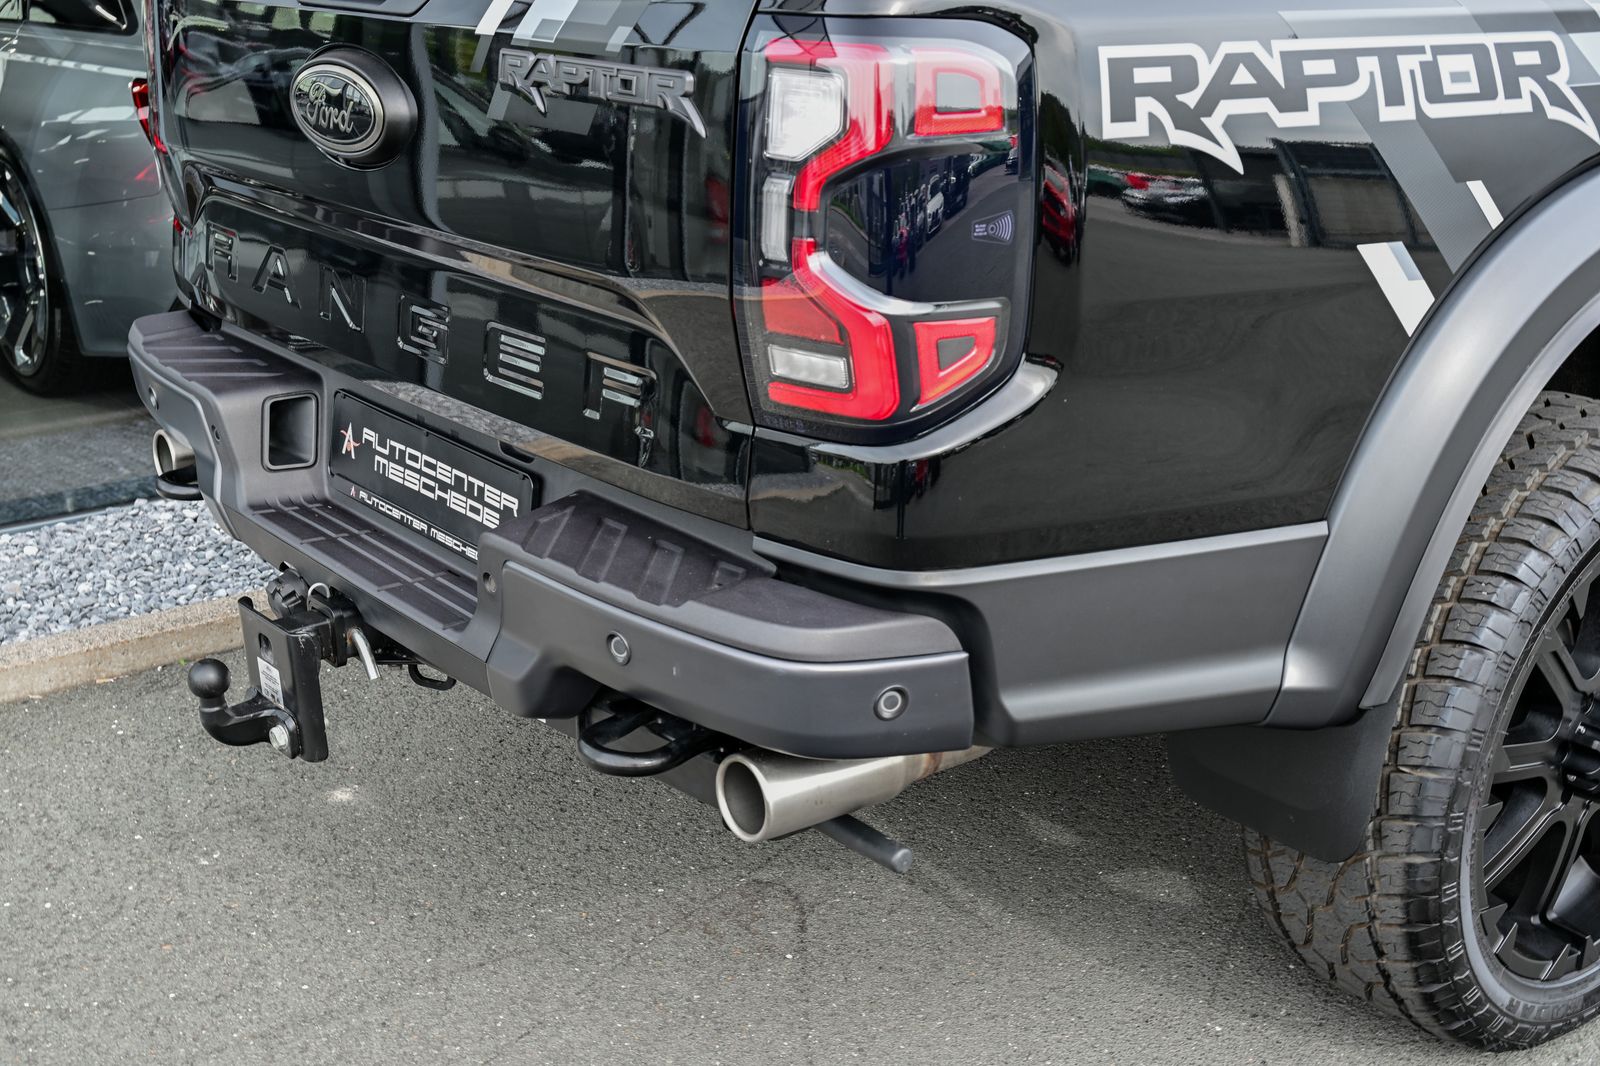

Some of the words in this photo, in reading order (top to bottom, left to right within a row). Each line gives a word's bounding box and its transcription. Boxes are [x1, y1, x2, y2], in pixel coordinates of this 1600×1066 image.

[306, 82, 354, 133] Ford
[499, 48, 707, 139] RAPTOR
[1098, 30, 1600, 174] RAPTOR
[205, 221, 657, 438] RANGER
[362, 427, 518, 517] AUTOCENTER
[374, 455, 500, 529] MESCHEDE
[359, 490, 428, 534] AUTOCENTER
[430, 527, 479, 561] MESCHE
